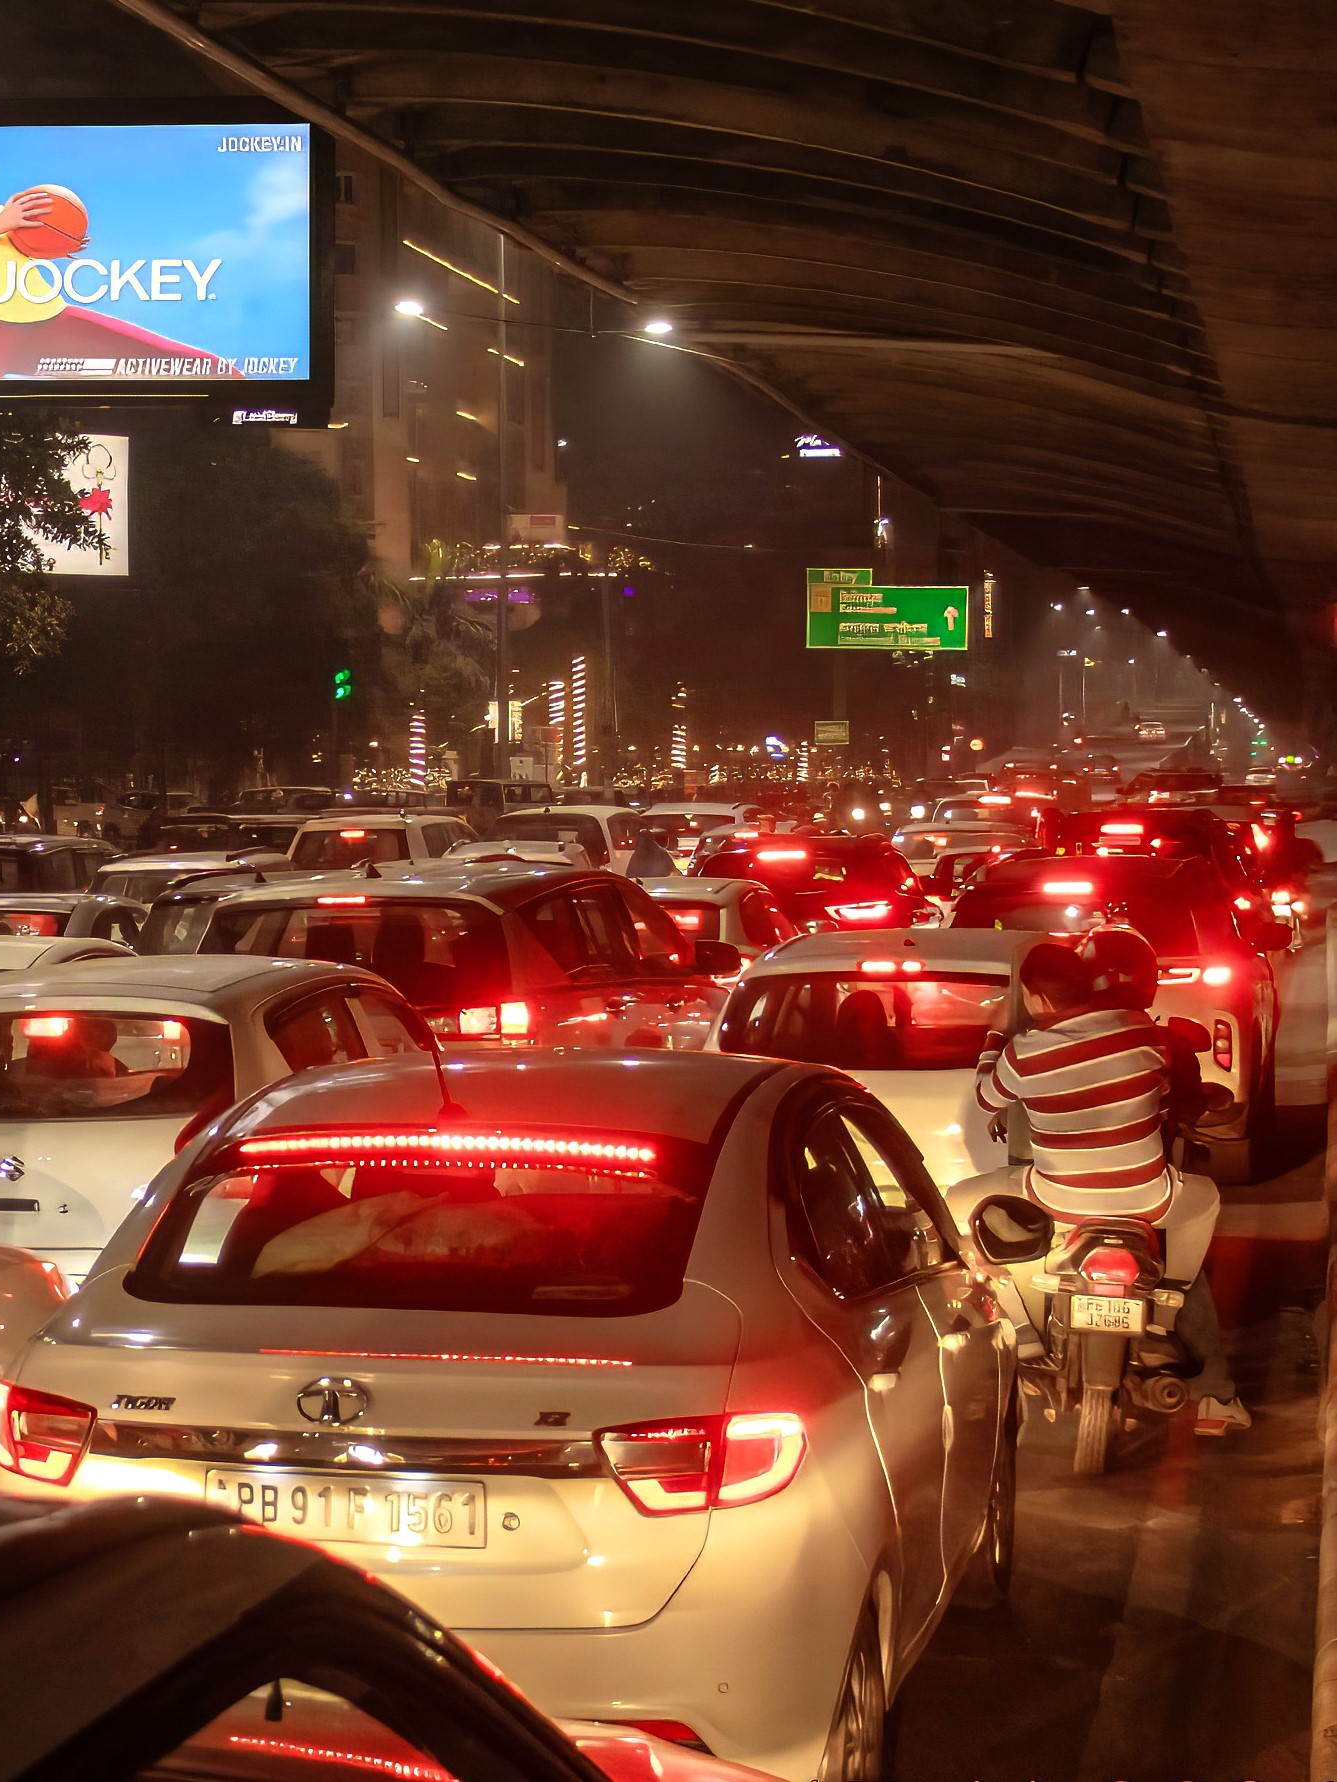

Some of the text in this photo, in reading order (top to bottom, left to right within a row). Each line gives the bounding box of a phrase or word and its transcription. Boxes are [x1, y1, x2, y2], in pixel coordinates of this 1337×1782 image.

[217, 136, 302, 152] JOCKEY.IN
[115, 358, 211, 376] ACTIVEWEAR
[243, 357, 299, 375] JOCKEY
[237, 1482, 279, 1523] PB
[384, 1491, 477, 1536] 1561
